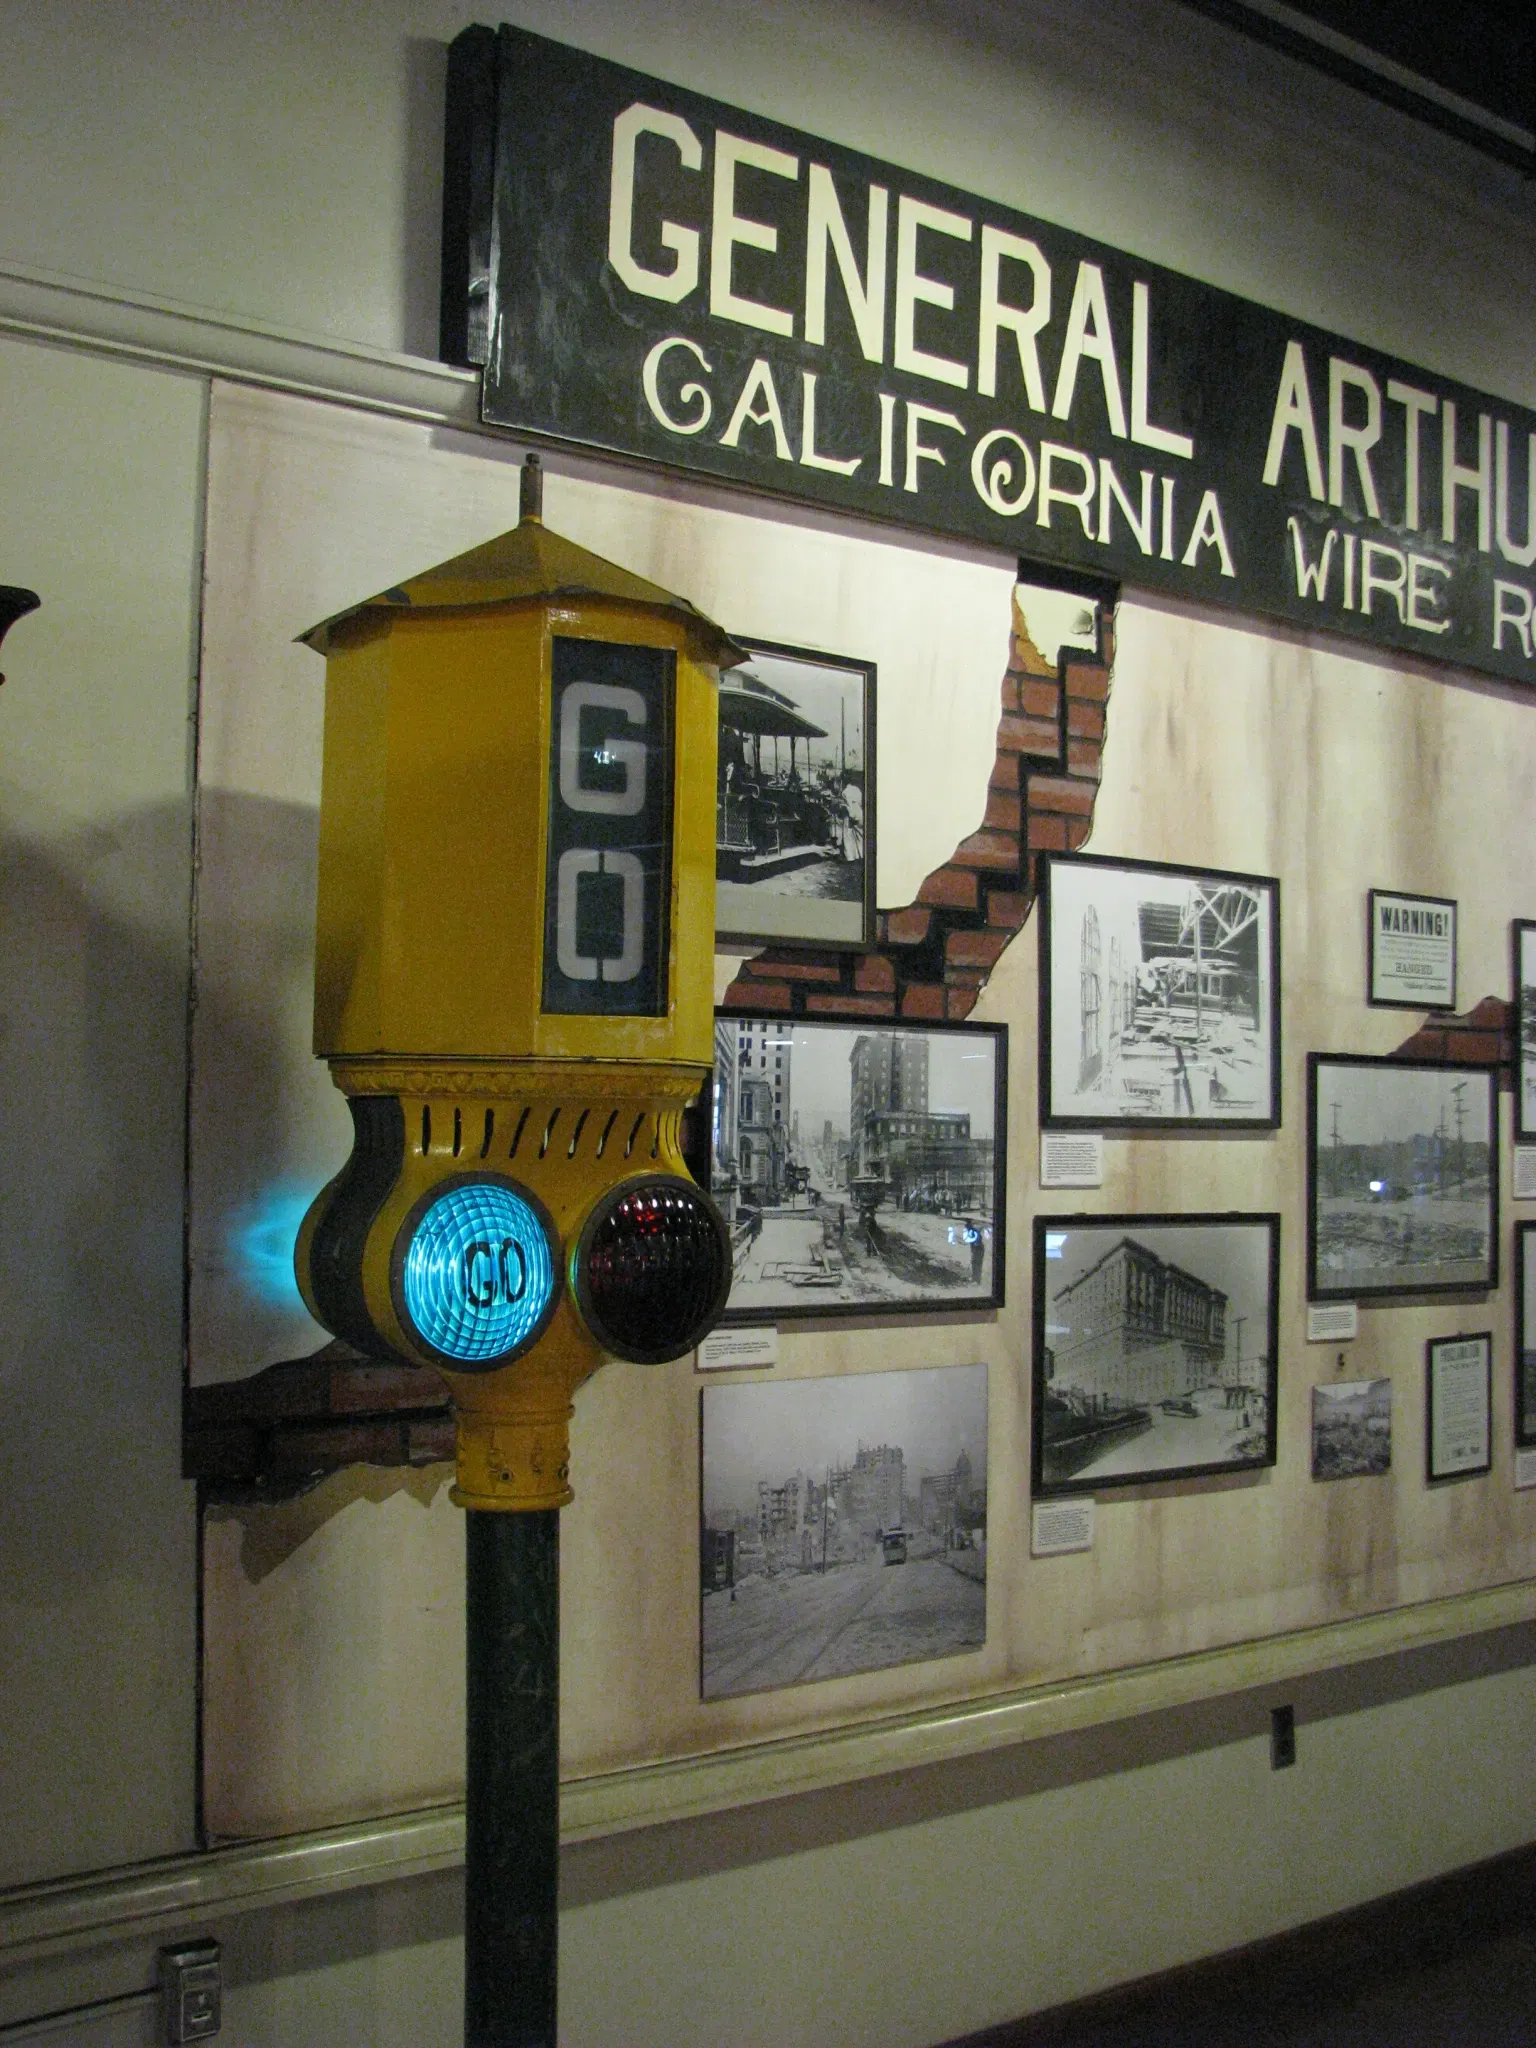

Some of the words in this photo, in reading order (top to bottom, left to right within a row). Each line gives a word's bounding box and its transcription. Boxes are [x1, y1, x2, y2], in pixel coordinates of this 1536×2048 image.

[608, 102, 1193, 459] GENERAL
[642, 337, 1236, 578] CALIFORNIA
[1287, 516, 1452, 633] WIRE
[1493, 578, 1536, 660] R
[557, 681, 647, 983] GO
[1380, 905, 1449, 937] WARNING!
[462, 1237, 527, 1309] GO
